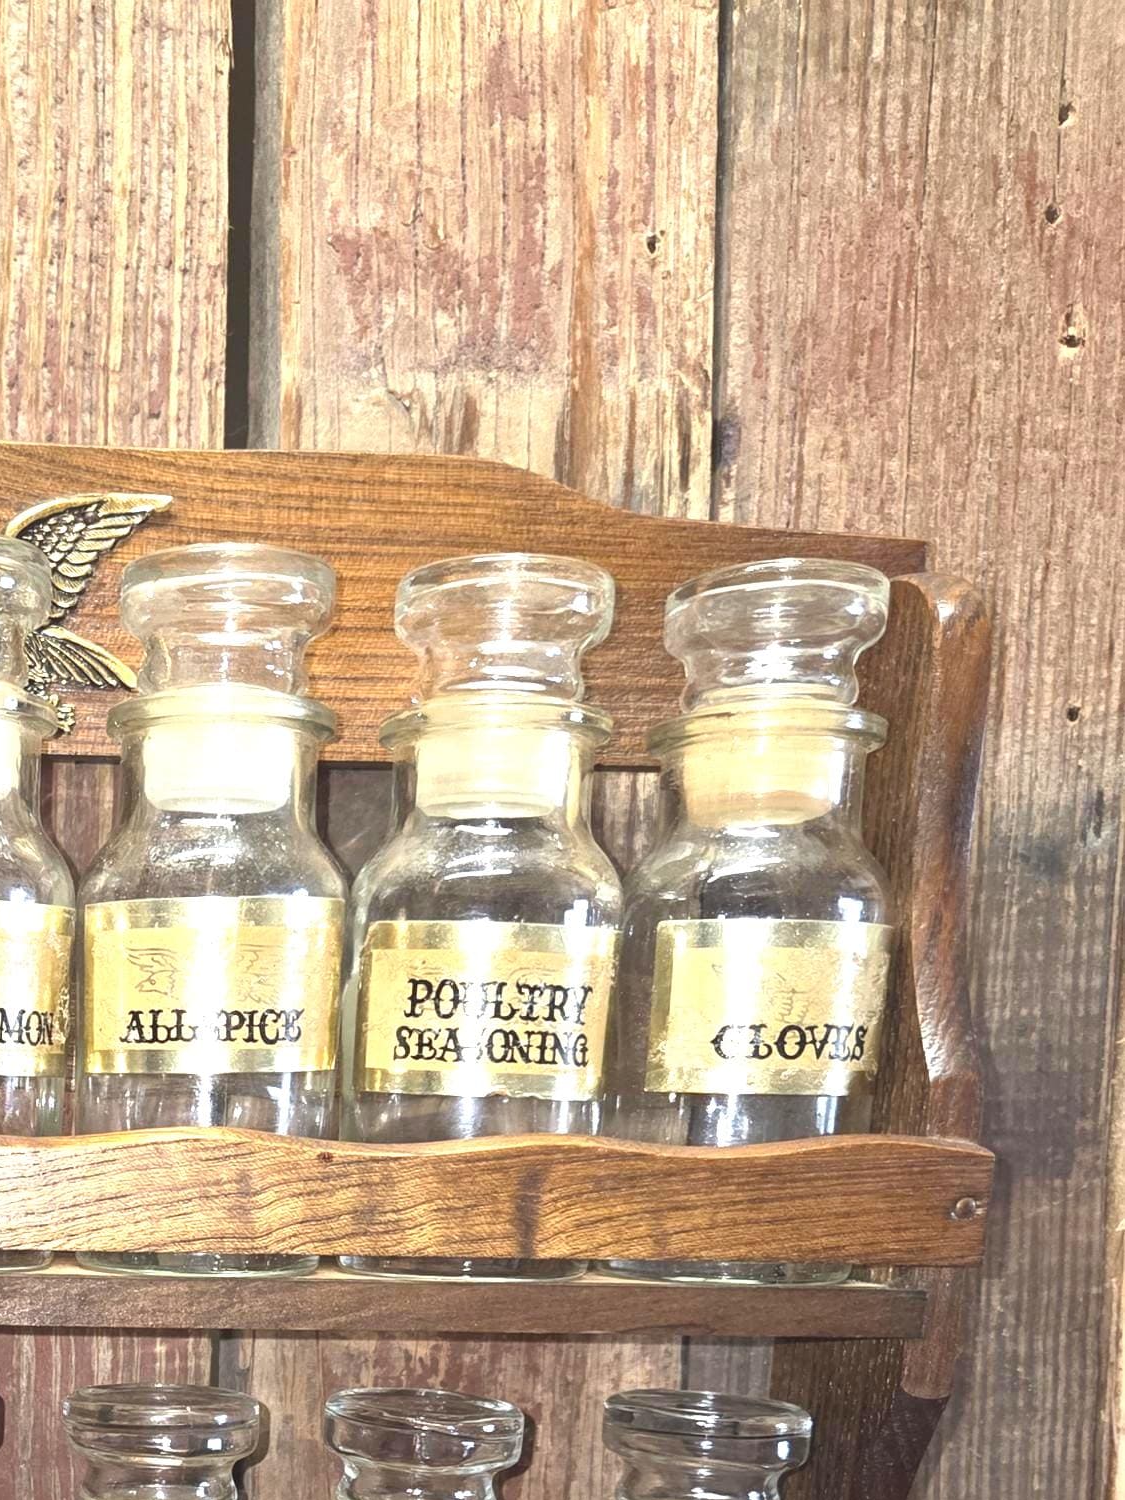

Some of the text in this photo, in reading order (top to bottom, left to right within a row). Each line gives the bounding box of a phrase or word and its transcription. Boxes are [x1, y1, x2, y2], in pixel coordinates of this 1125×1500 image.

[404, 978, 592, 1025] POULTRY
[119, 1008, 305, 1045] ALLPICE
[393, 1025, 589, 1067] SEAONING
[710, 1023, 868, 1062] CLOVES
